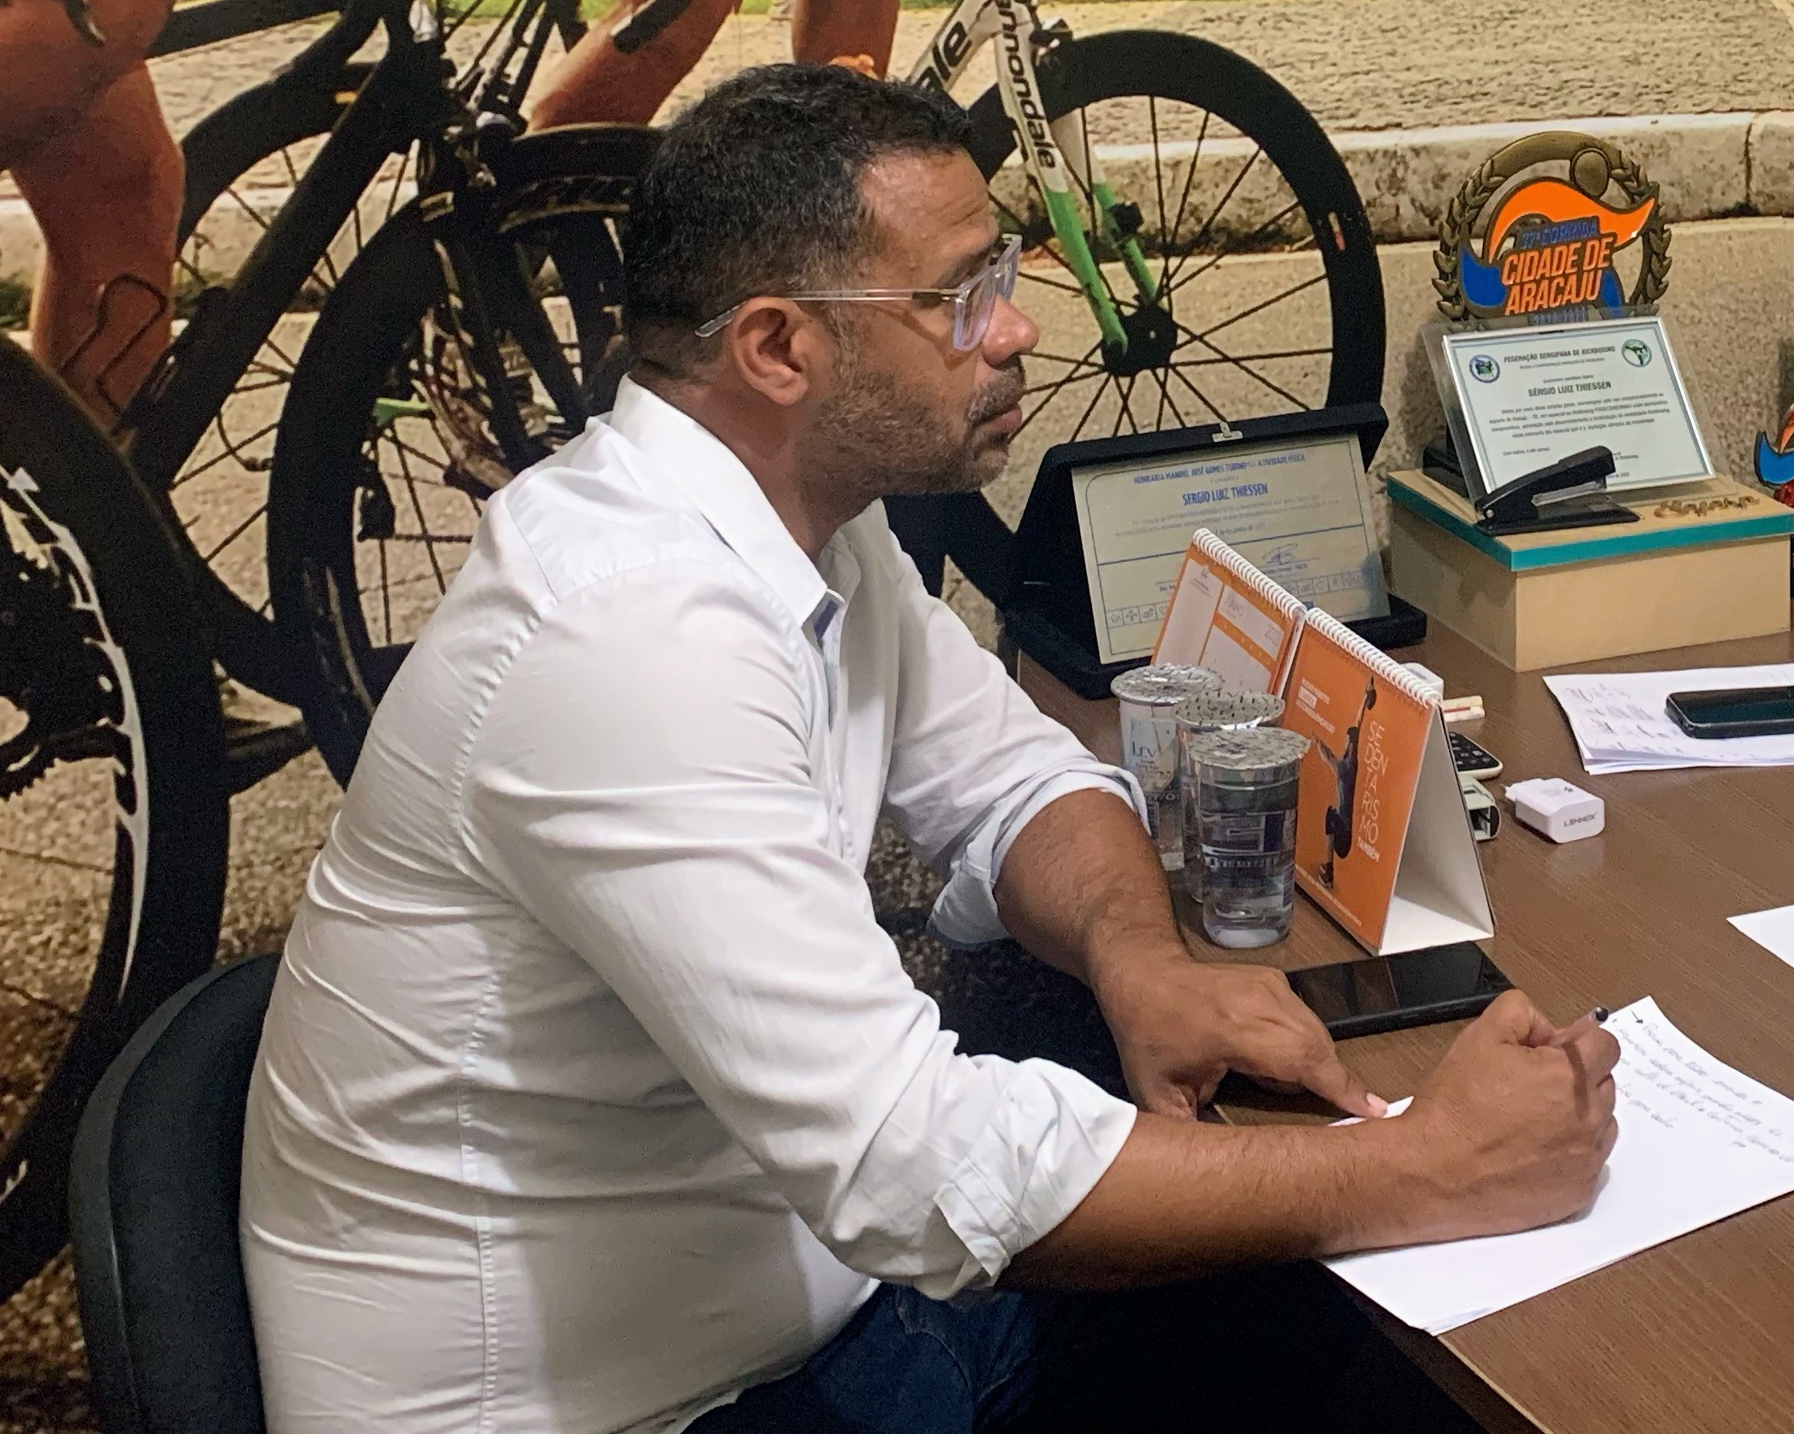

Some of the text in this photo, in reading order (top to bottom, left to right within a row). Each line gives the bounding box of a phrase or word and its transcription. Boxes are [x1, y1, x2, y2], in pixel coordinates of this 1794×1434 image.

[1501, 237, 1613, 286] CIDADE DE
[1505, 269, 1602, 316] ARACAJU
[1528, 381, 1612, 397] SÉRGIO LUIZ THIESSEN
[1212, 487, 1230, 501] LUIZ
[1231, 482, 1268, 499] THIESSEN
[1359, 815, 1379, 845] MO
